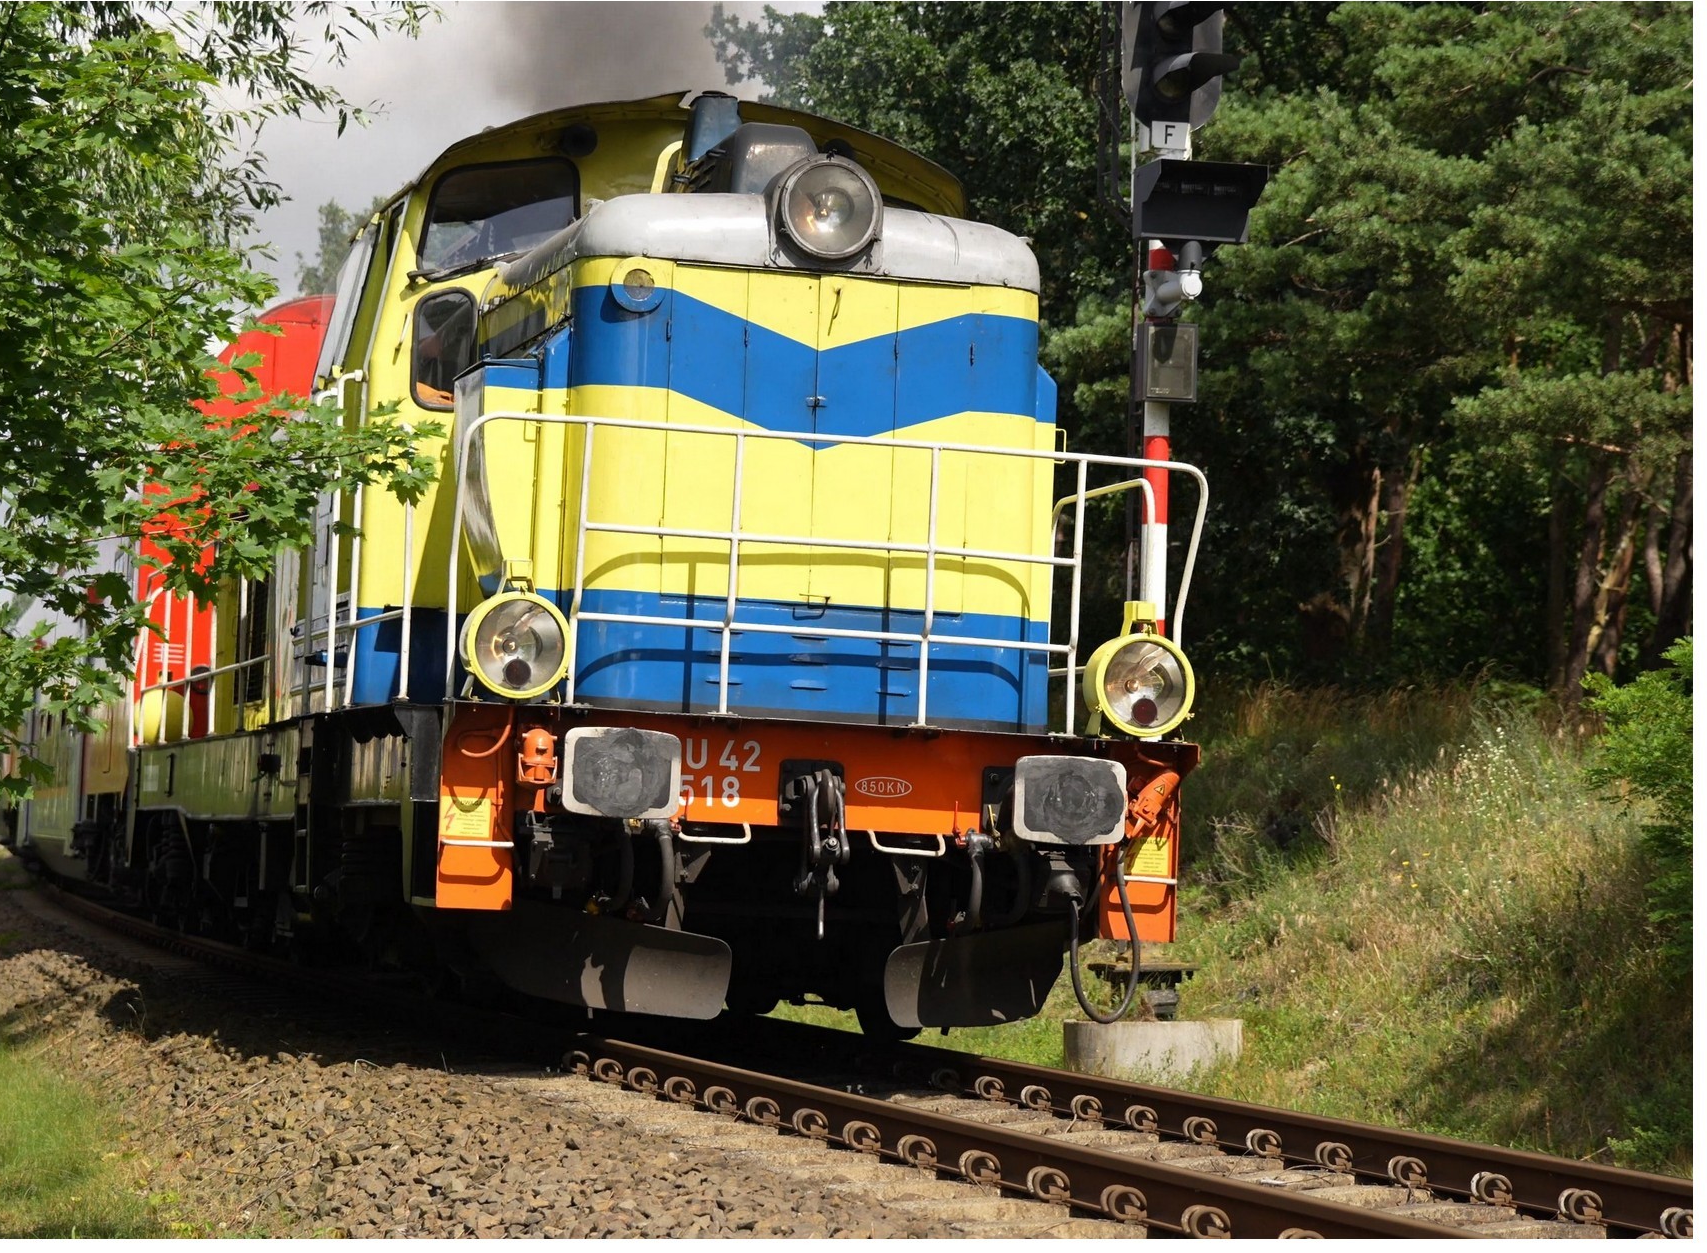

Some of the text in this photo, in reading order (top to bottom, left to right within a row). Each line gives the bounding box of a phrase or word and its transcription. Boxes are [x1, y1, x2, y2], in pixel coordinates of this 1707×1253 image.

[1164, 124, 1176, 145] F
[719, 740, 761, 772] 42
[679, 774, 740, 808] 518
[861, 780, 905, 794] 850KN
